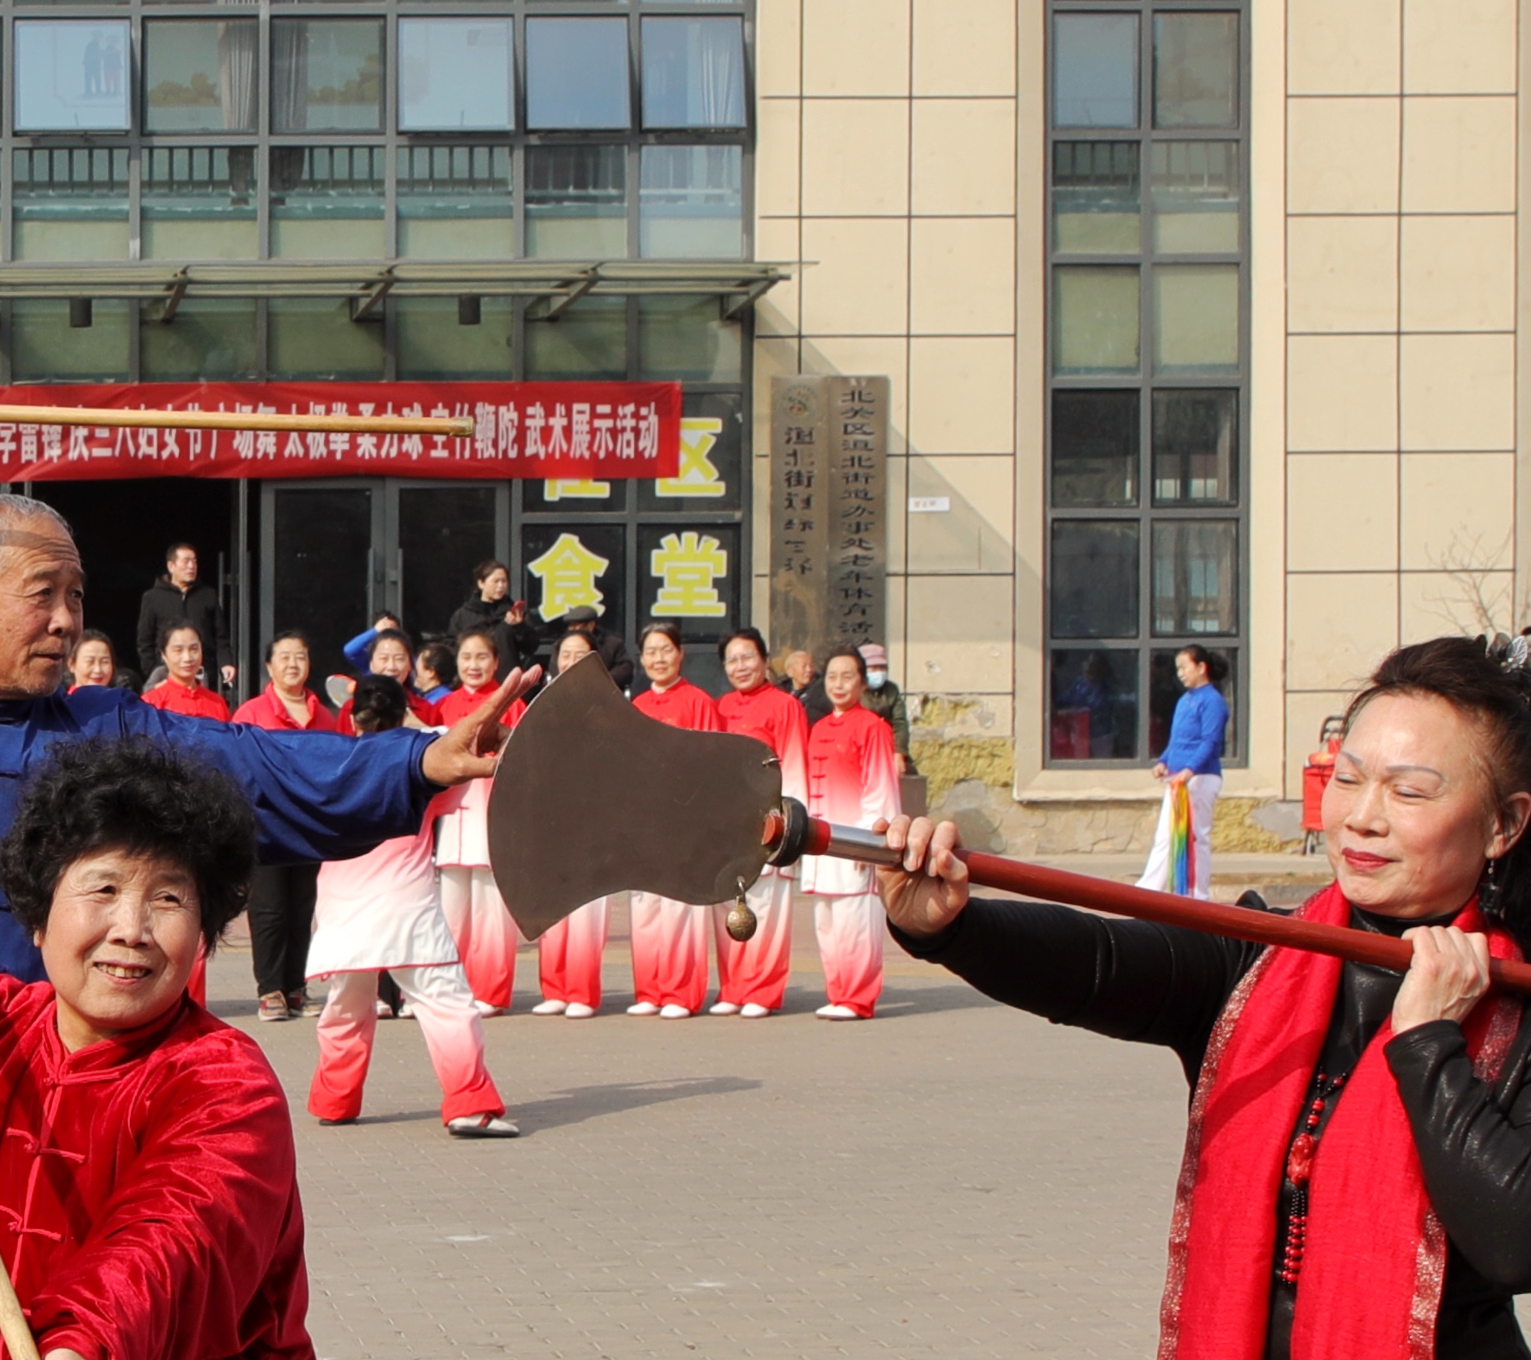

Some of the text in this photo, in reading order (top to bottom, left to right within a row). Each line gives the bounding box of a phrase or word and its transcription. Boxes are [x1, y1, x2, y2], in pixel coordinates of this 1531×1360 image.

[524, 402, 659, 460] 武术展示活动
[527, 531, 728, 623] 食堂
